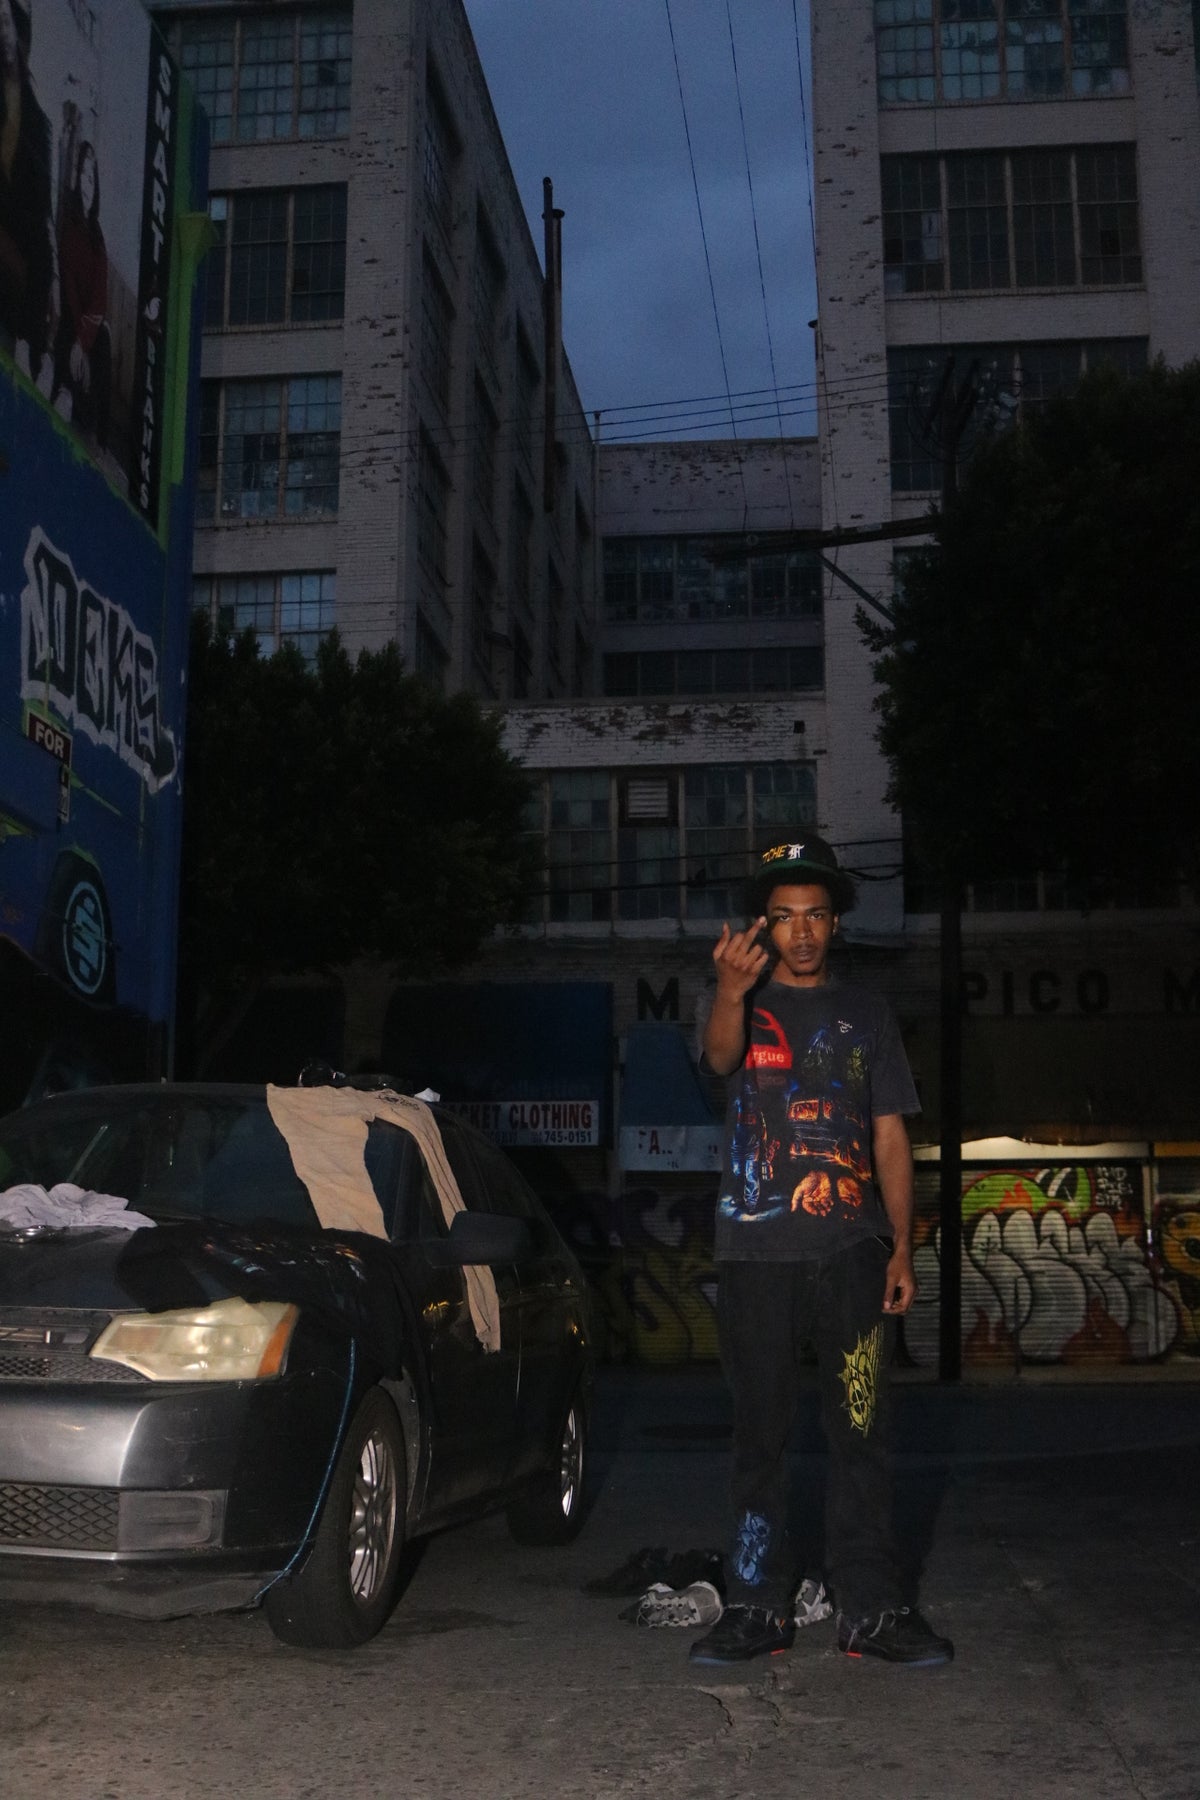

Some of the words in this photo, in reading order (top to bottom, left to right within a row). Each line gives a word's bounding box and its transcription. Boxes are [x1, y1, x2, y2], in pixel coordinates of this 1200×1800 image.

[152, 56, 172, 263] SMART
[139, 336, 156, 510] BLANKS
[34, 720, 65, 760] FOR
[959, 969, 1110, 1015] PICO
[509, 1103, 593, 1130] CLOTHING
[544, 1130, 592, 1144] 745-0151
